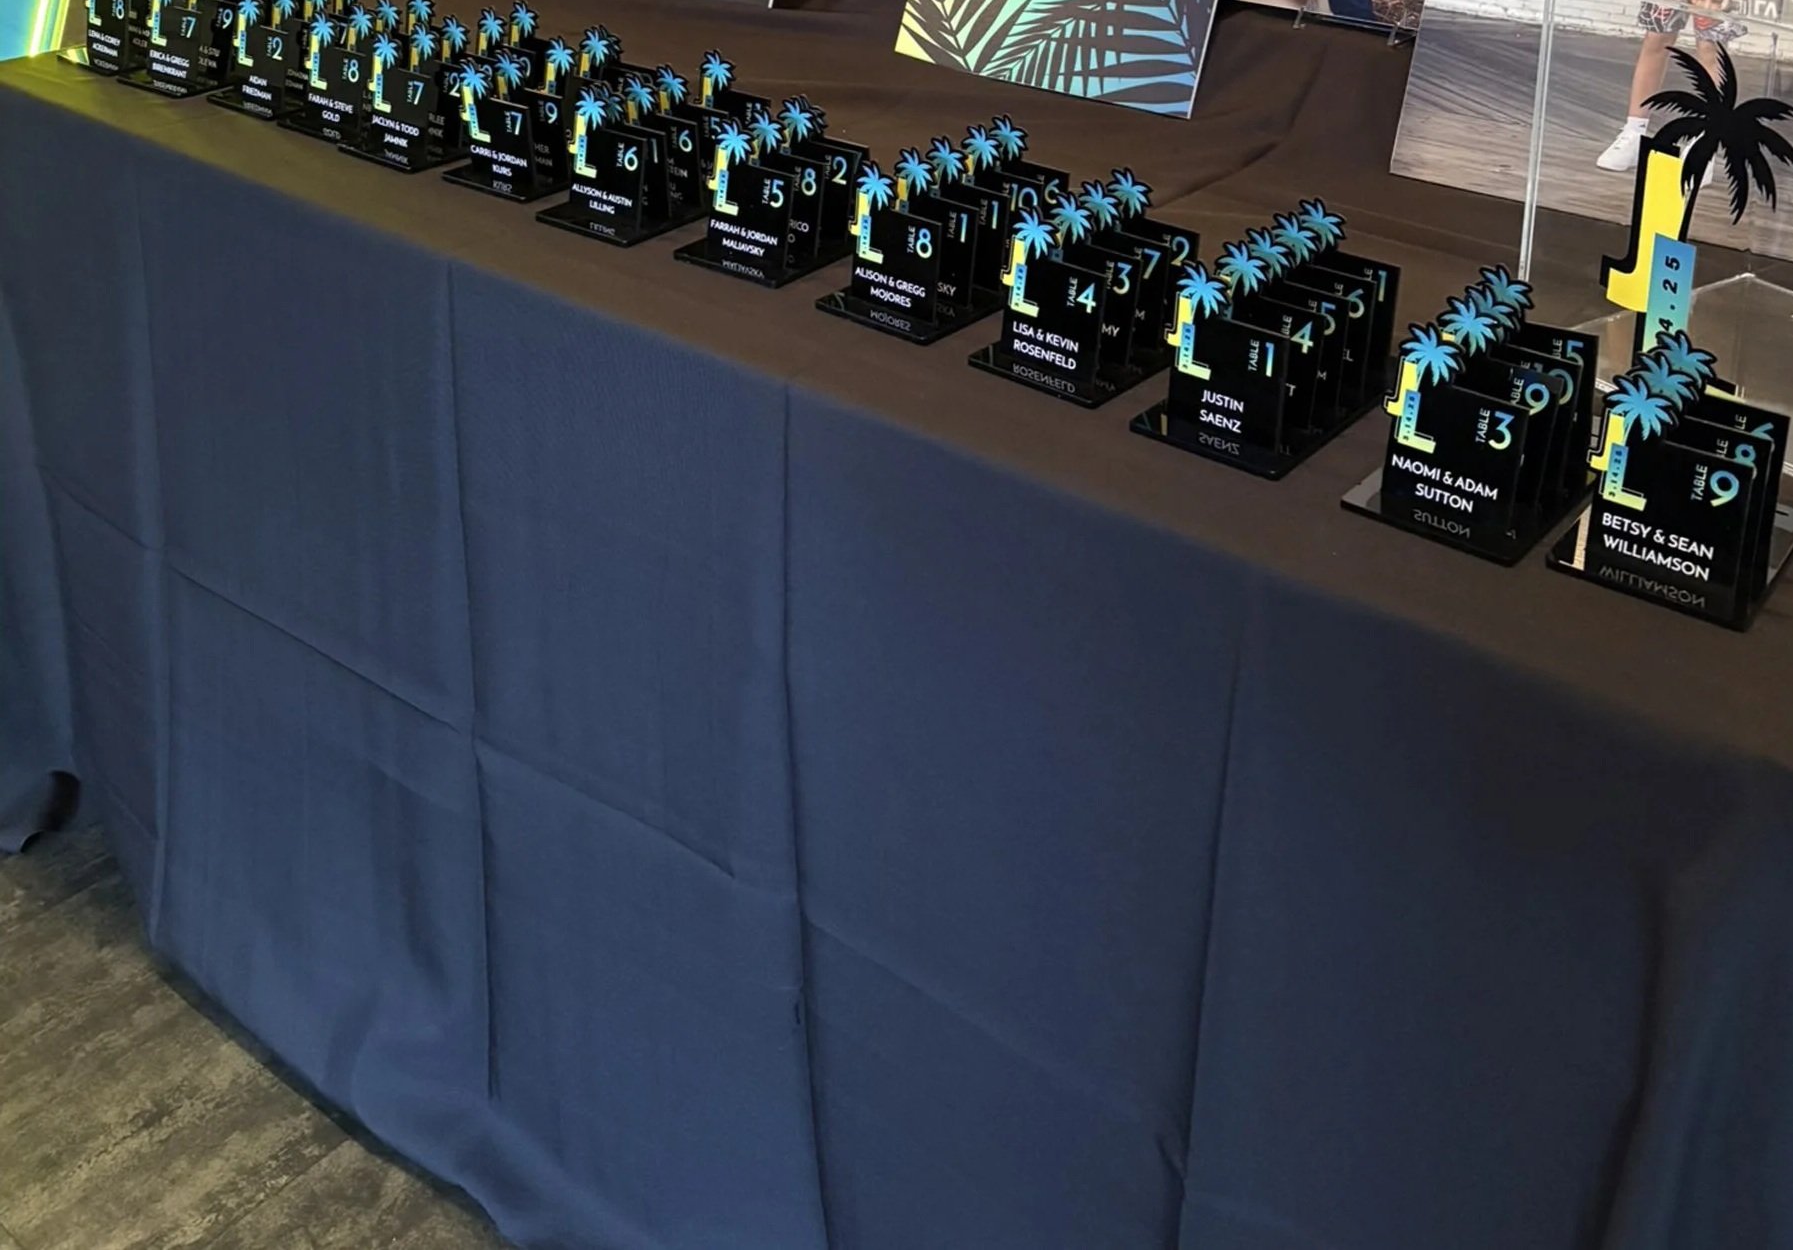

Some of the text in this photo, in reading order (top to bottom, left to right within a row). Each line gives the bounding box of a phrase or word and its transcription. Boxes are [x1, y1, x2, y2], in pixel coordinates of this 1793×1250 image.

[186, 16, 196, 39] 7
[222, 8, 233, 29] 9
[272, 37, 283, 61] 2
[347, 59, 359, 83] 8
[449, 72, 461, 98] 2
[413, 81, 424, 105] 7
[322, 110, 340, 123] GOLD
[510, 111, 522, 136] 7
[545, 102, 558, 124] 9
[679, 130, 693, 152] 6
[616, 142, 638, 171] TABLE 6
[832, 156, 847, 185] 2
[761, 178, 784, 208] TABLE 5
[802, 168, 816, 196] 8
[960, 213, 968, 243] 1
[991, 200, 999, 230] 1
[710, 219, 740, 235] FARRAH
[746, 230, 778, 246] JORDAN
[907, 225, 932, 259] TABLE 8
[1143, 248, 1161, 279] 7
[1170, 236, 1189, 266] 2
[855, 266, 887, 284] ALISON
[896, 279, 926, 298] GREGG
[1112, 261, 1132, 295] 3
[1378, 270, 1387, 302] 1
[870, 286, 912, 308] MOJORES
[1066, 276, 1096, 314] TABLE 4
[1321, 301, 1336, 336] 5
[1013, 320, 1079, 353] LISA & KEVIN
[1290, 320, 1314, 354] 4
[1013, 339, 1077, 370] ROSENFELD
[1247, 339, 1275, 378] TABLE 1
[1201, 389, 1244, 413] JUSTIN
[1525, 382, 1550, 416] 9
[1199, 409, 1242, 434] SAENZ
[1475, 408, 1515, 450] TABLE 3
[1392, 453, 1498, 501] NAOMI & ADAM
[1691, 464, 1739, 507] TABLE 9
[1415, 483, 1473, 513] SUTTON
[1602, 512, 1714, 561] BETSY & SEAN
[1603, 534, 1710, 582] WILLIAMSON
